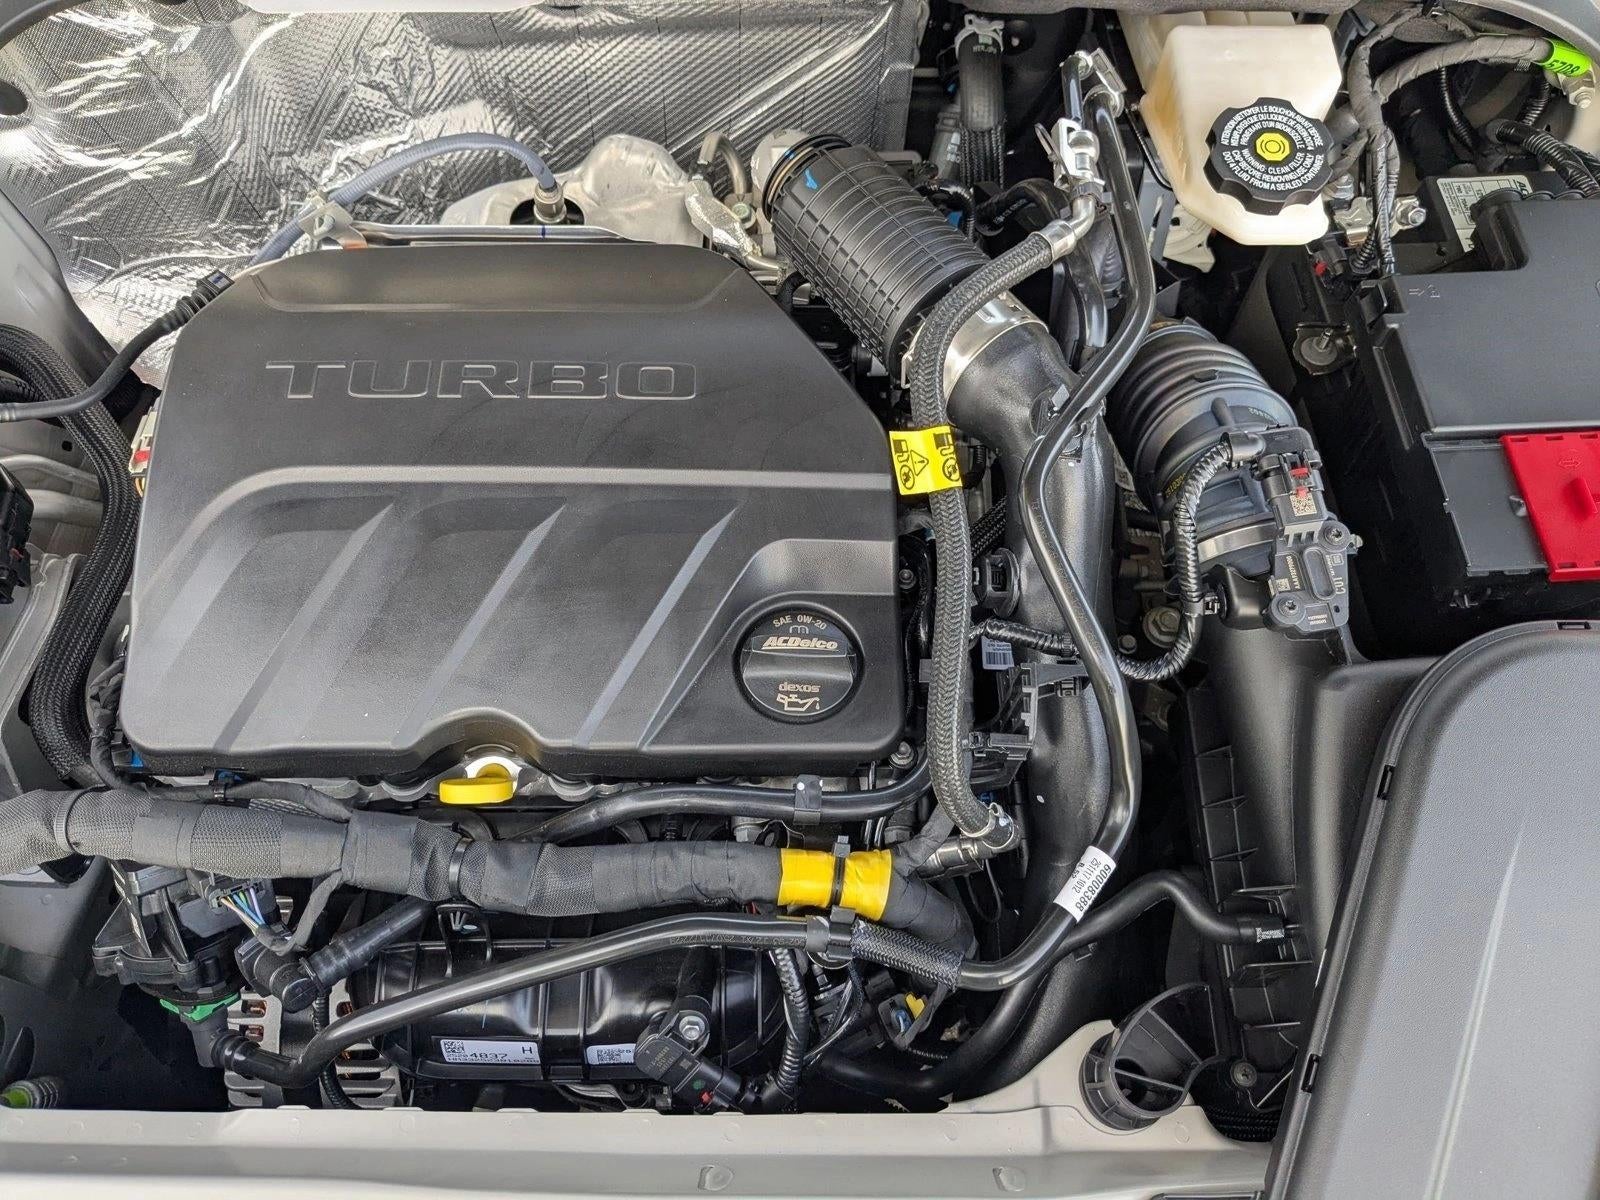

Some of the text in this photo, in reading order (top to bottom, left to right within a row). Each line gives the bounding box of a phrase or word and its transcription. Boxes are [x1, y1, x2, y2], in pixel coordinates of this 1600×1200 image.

[1260, 105, 1268, 113] LE
[1231, 149, 1243, 161] CAP
[1238, 160, 1262, 180] BEFORE
[1302, 152, 1315, 168] ONLY
[1267, 166, 1291, 175] CLEAN
[1288, 152, 1305, 170] FILLER
[1232, 165, 1250, 182] FLUID
[1249, 177, 1270, 190] FROM
[1276, 179, 1303, 191] SEALED
[265, 360, 697, 400] TURBO
[773, 614, 828, 630] SAE 0W-20
[761, 636, 839, 651] ACDelco
[778, 682, 820, 693] dexos
[521, 1046, 533, 1055] H
